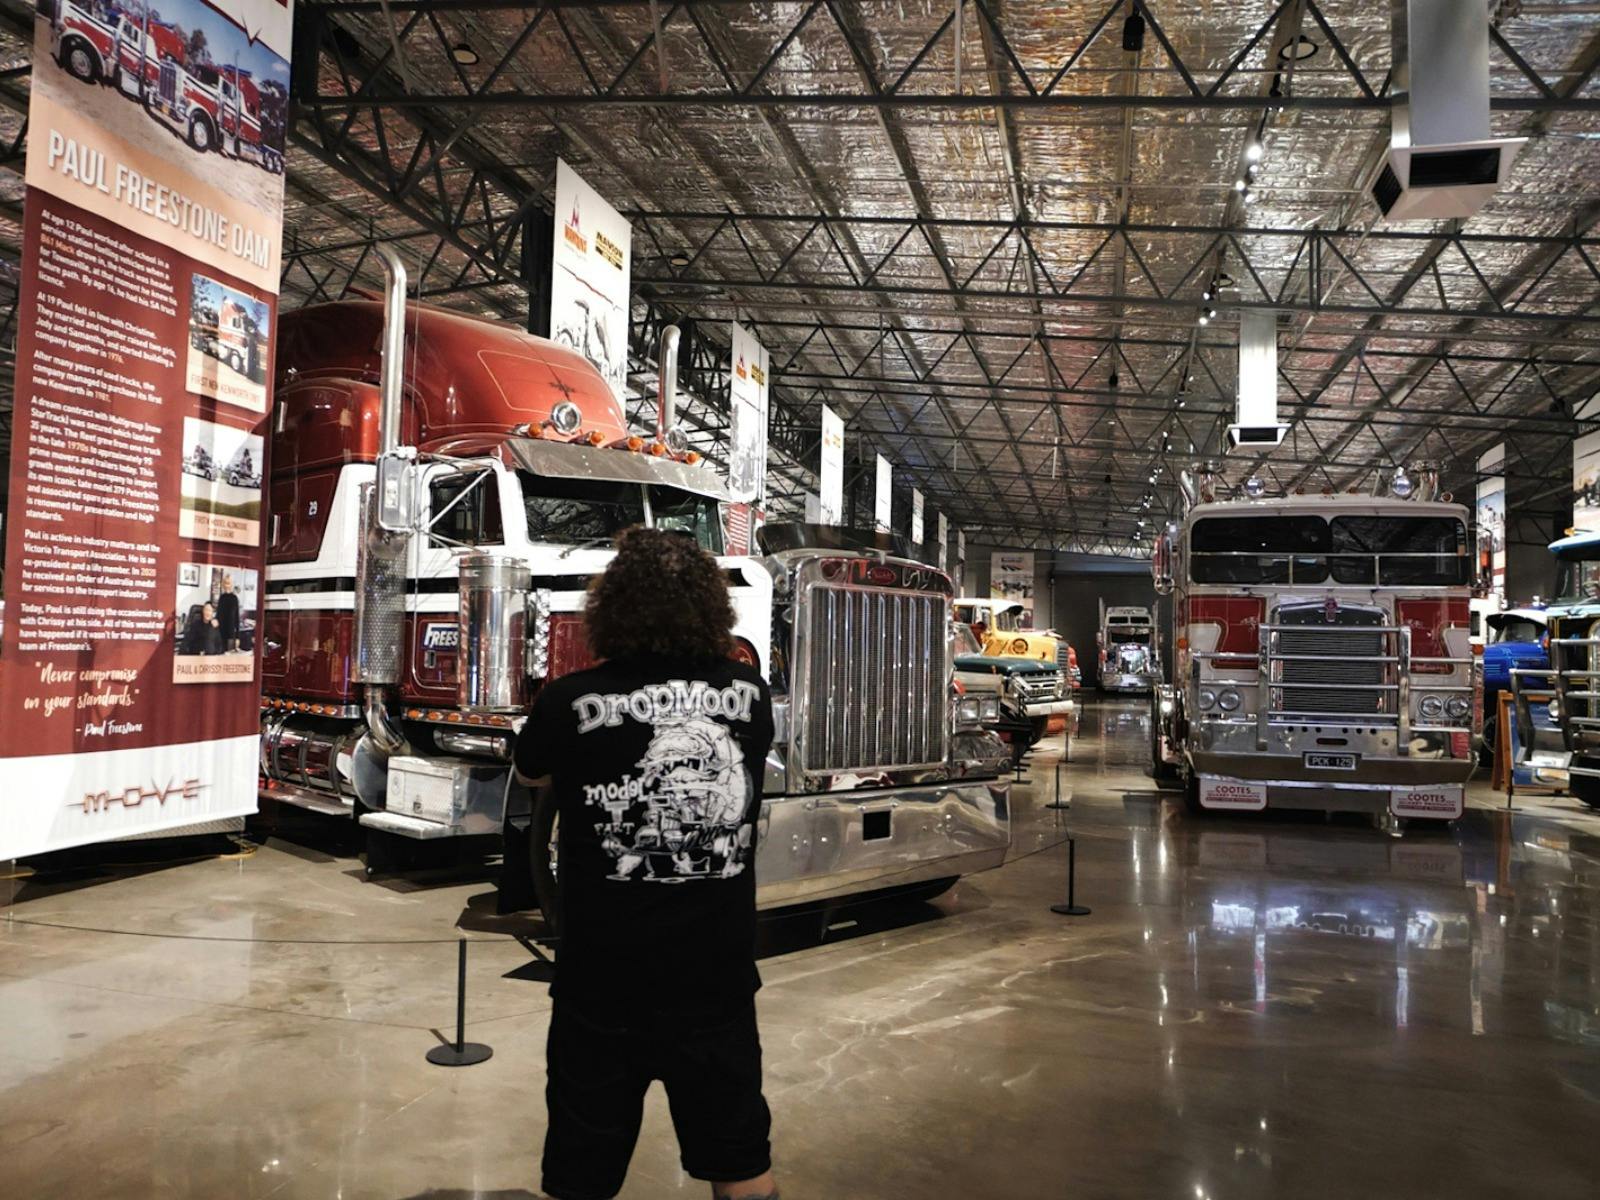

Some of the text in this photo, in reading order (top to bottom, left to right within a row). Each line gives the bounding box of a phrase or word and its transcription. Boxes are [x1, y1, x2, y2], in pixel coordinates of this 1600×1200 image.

[47, 128, 270, 269] PAUL FREESTONE OAM
[38, 271, 65, 288] licence.
[36, 303, 53, 318] They
[54, 311, 85, 327] married
[85, 322, 99, 332] and
[100, 325, 126, 341] together
[127, 336, 148, 348] raised
[33, 349, 51, 362] After
[52, 356, 73, 370] many
[74, 362, 95, 374] years
[103, 371, 119, 381] used
[119, 374, 142, 389] trucks,
[143, 380, 155, 391] the
[33, 363, 65, 380] company
[66, 373, 99, 387] managed
[107, 384, 137, 398] purchase
[137, 391, 146, 400] its
[147, 393, 162, 404] first
[38, 397, 61, 410] dream
[62, 404, 94, 418] contract
[94, 412, 108, 421] with
[40, 424, 62, 435] years.
[63, 428, 78, 438] The
[79, 431, 96, 442] fleet
[97, 436, 112, 445] grew
[113, 438, 129, 449] from
[130, 444, 141, 452] one
[143, 445, 161, 456] truck
[70, 418, 85, 428] was
[86, 422, 112, 434] secured
[112, 428, 131, 438] which
[132, 431, 154, 443] lasted
[29, 447, 154, 477] prime movers and trailers today. This
[28, 460, 53, 470] growth
[54, 464, 85, 476] enabled
[86, 468, 97, 478] the
[98, 472, 125, 484] company
[134, 477, 157, 488] import
[27, 484, 40, 493] and
[41, 487, 81, 499] associated
[82, 493, 101, 502] spare
[101, 496, 120, 505] parts.
[38, 474, 53, 483] own
[54, 475, 76, 486] iconic
[77, 479, 91, 489] late
[92, 483, 112, 492] model
[125, 487, 159, 500] Peterbilts
[25, 509, 63, 521] standards.
[34, 498, 70, 510] renowned
[71, 502, 83, 511] for
[84, 506, 124, 517] presentation
[125, 511, 137, 519] and
[138, 512, 154, 522] high
[309, 501, 318, 515] 29
[24, 529, 41, 539] Paul
[50, 534, 72, 543] active
[82, 536, 109, 548] industry
[109, 541, 135, 550] matters
[150, 544, 160, 552] the
[23, 543, 51, 554] Victoria
[53, 546, 89, 558] Transport
[90, 550, 127, 561] Association.
[21, 582, 32, 591] for
[33, 584, 64, 593] services
[75, 586, 87, 594] the
[87, 587, 118, 597] transport
[118, 589, 148, 599] industry.
[33, 572, 64, 581] received
[76, 574, 96, 583] Order
[104, 577, 133, 586] Australia
[134, 580, 155, 588] medal
[20, 603, 43, 614] Today,
[45, 605, 62, 613] Paul
[72, 606, 86, 614] still
[86, 607, 105, 617] doing
[105, 608, 116, 616] the
[20, 616, 36, 625] with
[37, 617, 65, 627] Chrissy
[75, 618, 86, 626] his
[87, 619, 101, 627] side.
[103, 619, 113, 627] All
[121, 620, 134, 628] this
[135, 621, 155, 629] would
[19, 629, 37, 637] have
[38, 629, 75, 639] happened
[111, 631, 119, 639] for
[133, 633, 159, 641] amazing
[423, 623, 459, 648] FREES
[78, 669, 138, 689] compromise
[176, 664, 192, 674] PAUL
[23, 696, 40, 709] on
[43, 695, 74, 717] your
[83, 720, 106, 737] Paul
[1215, 785, 1251, 794] COOTES
[1407, 793, 1446, 803] COOTES
